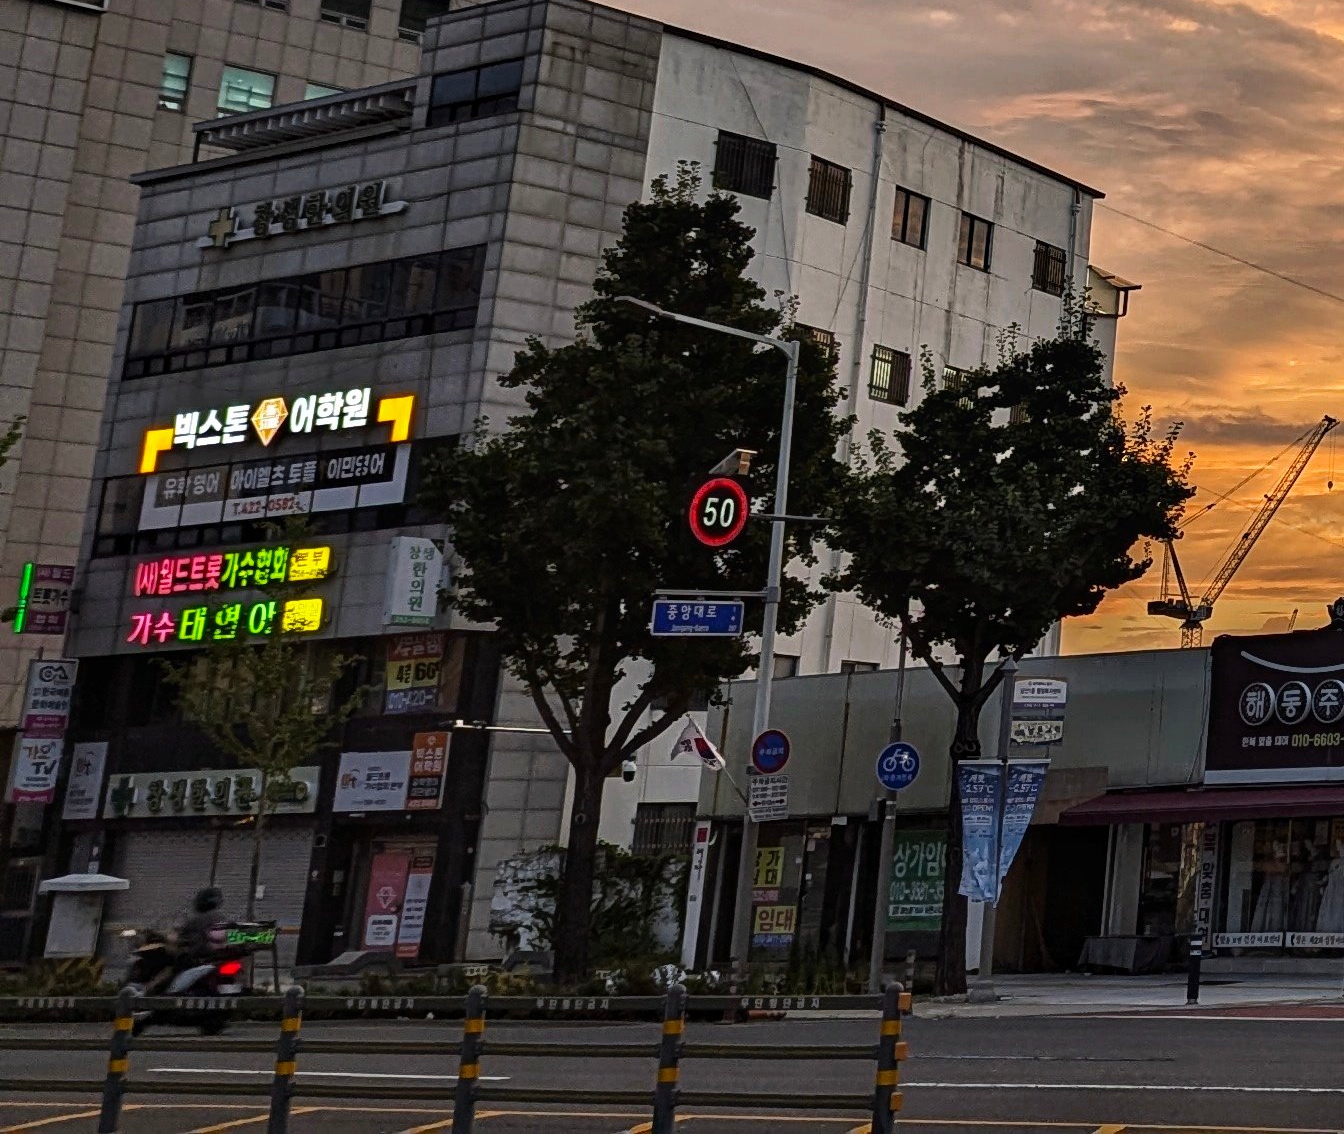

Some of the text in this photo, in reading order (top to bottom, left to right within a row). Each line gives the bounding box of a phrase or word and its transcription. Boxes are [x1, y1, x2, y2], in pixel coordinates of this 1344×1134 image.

[173, 403, 251, 449] 빅스톤
[290, 388, 371, 434] 어학원
[702, 496, 735, 528] 50
[127, 611, 176, 645] 가수
[666, 604, 718, 621] 중앙대로
[758, 908, 794, 932] 임대
